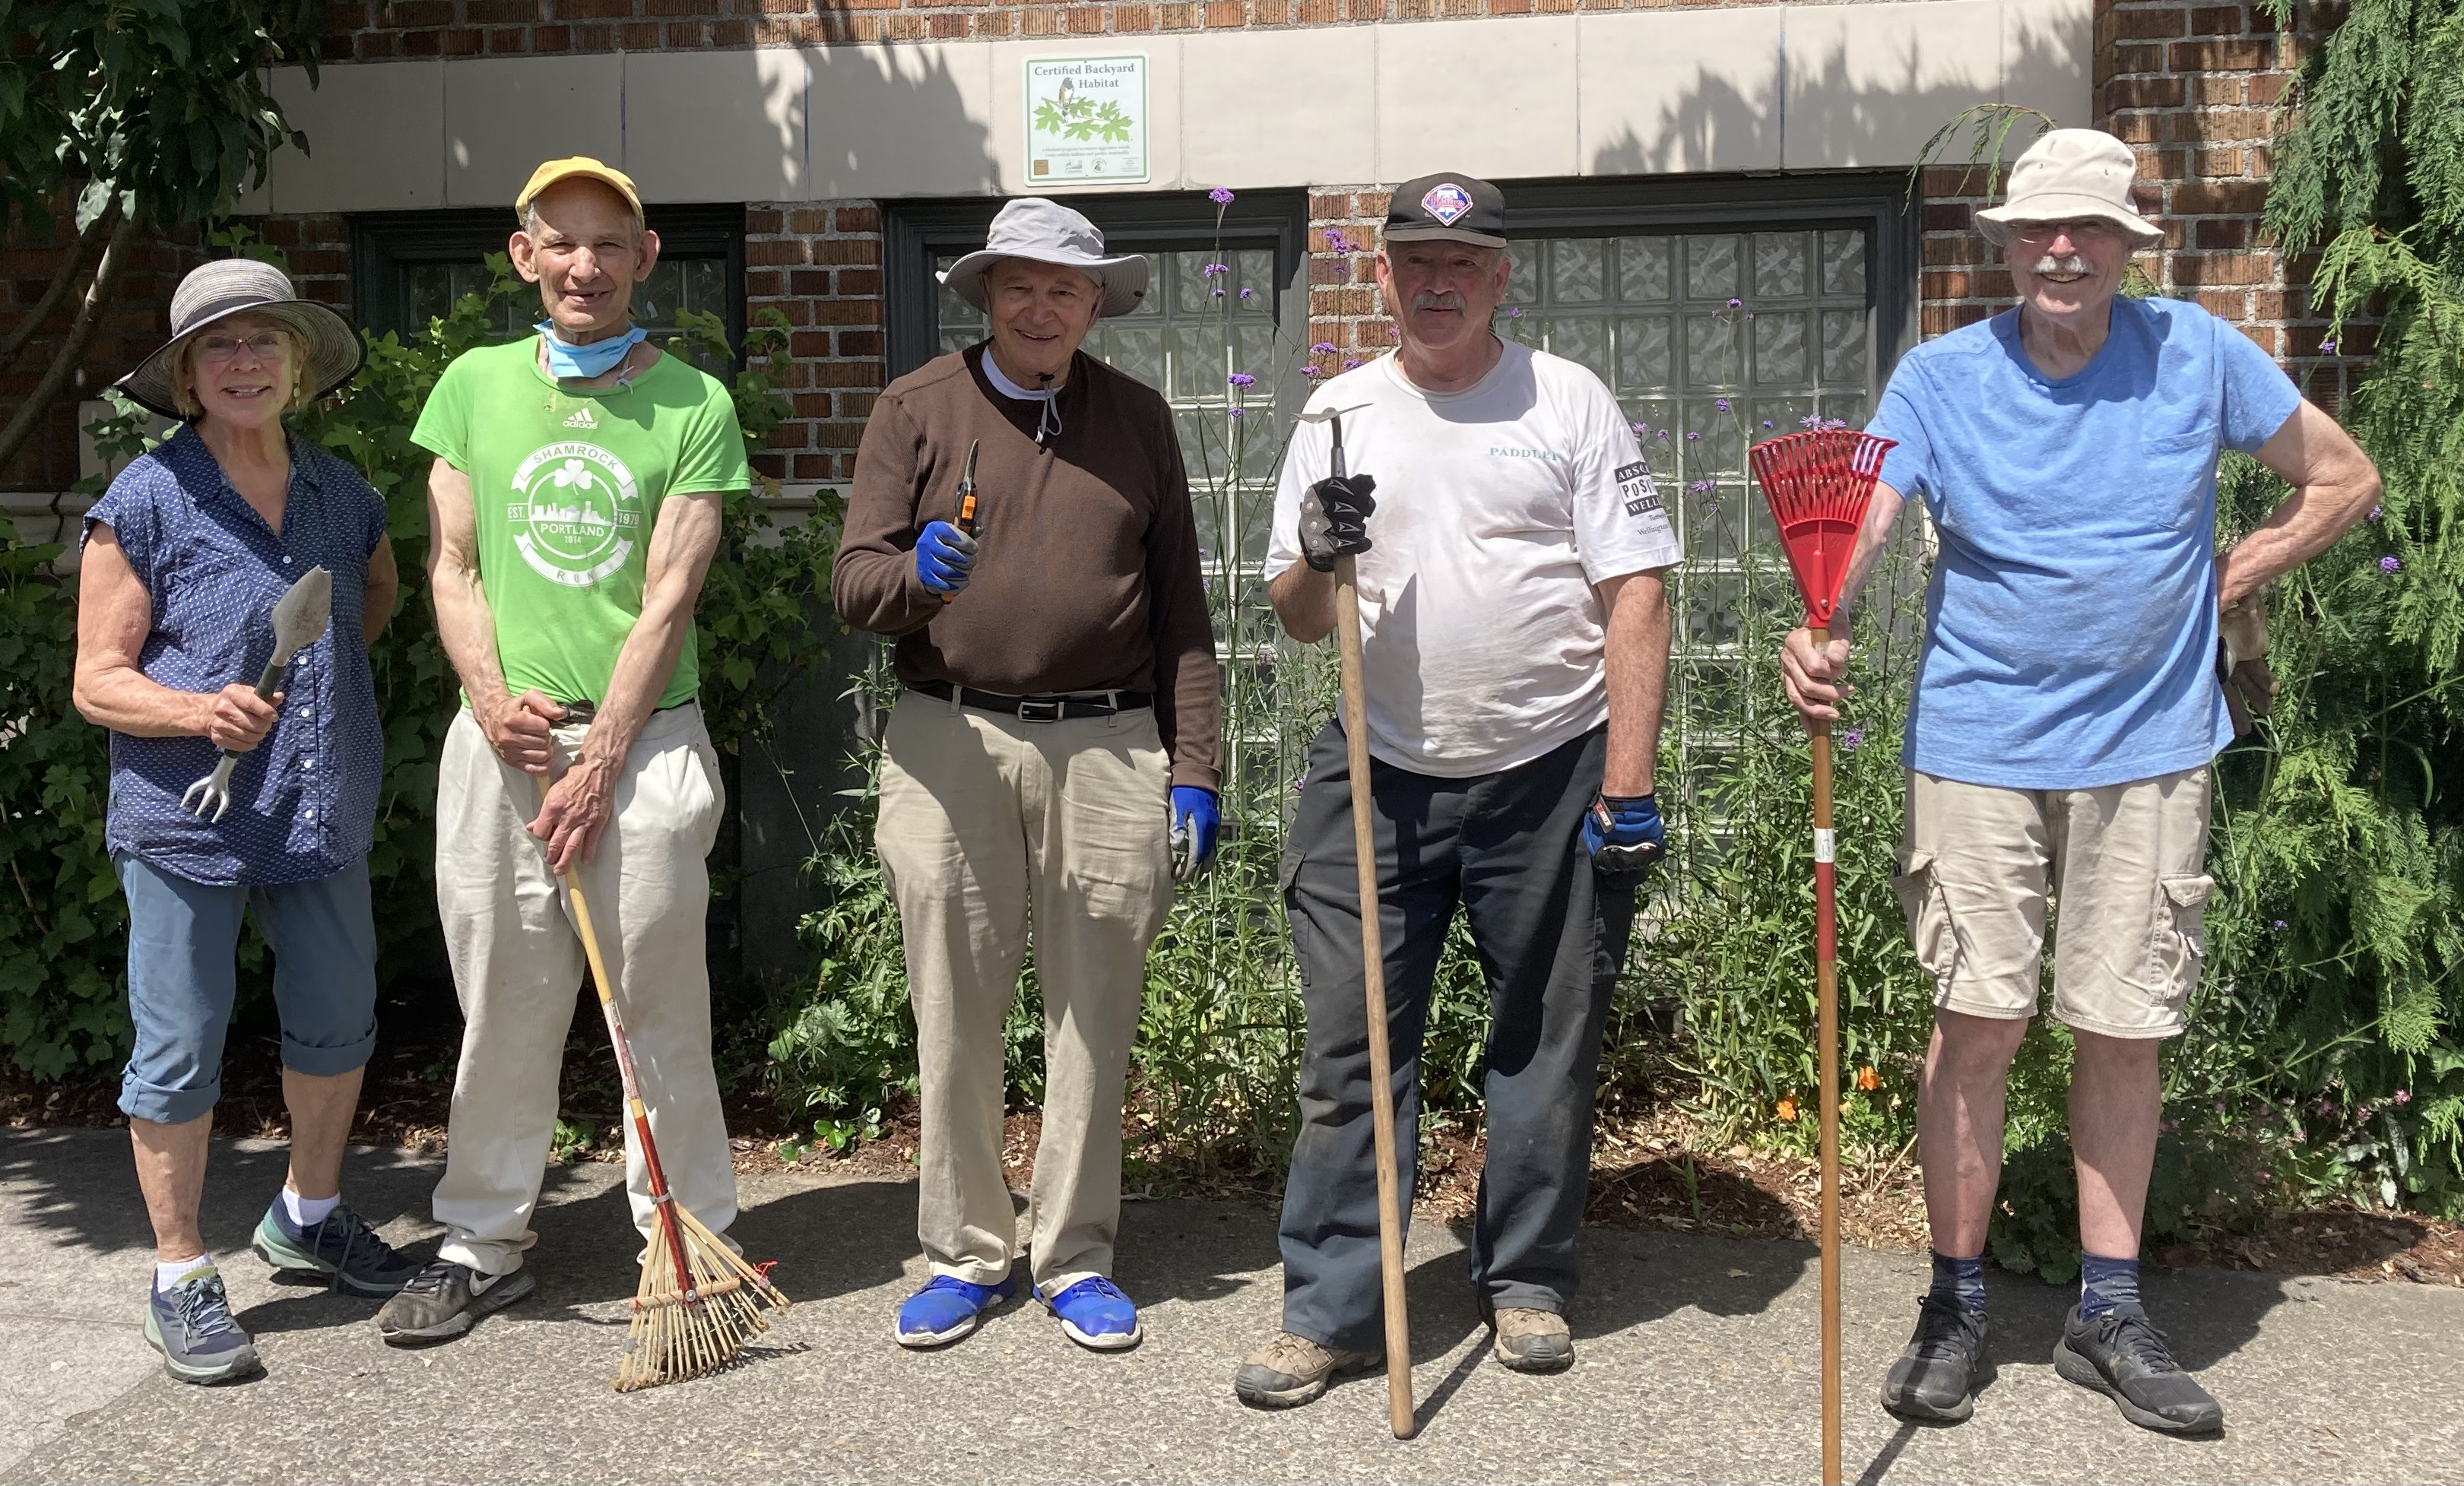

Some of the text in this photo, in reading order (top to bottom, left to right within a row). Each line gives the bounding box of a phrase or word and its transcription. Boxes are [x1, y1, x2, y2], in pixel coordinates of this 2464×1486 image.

[1034, 62, 1134, 76] Certified Backyard
[1079, 78, 1120, 89] Habitat
[562, 419, 598, 429] adidas
[533, 445, 619, 471] SHAMROCK
[508, 506, 640, 525] EST. 1979
[541, 523, 604, 537] PORTLAND
[557, 570, 595, 584] RUN
